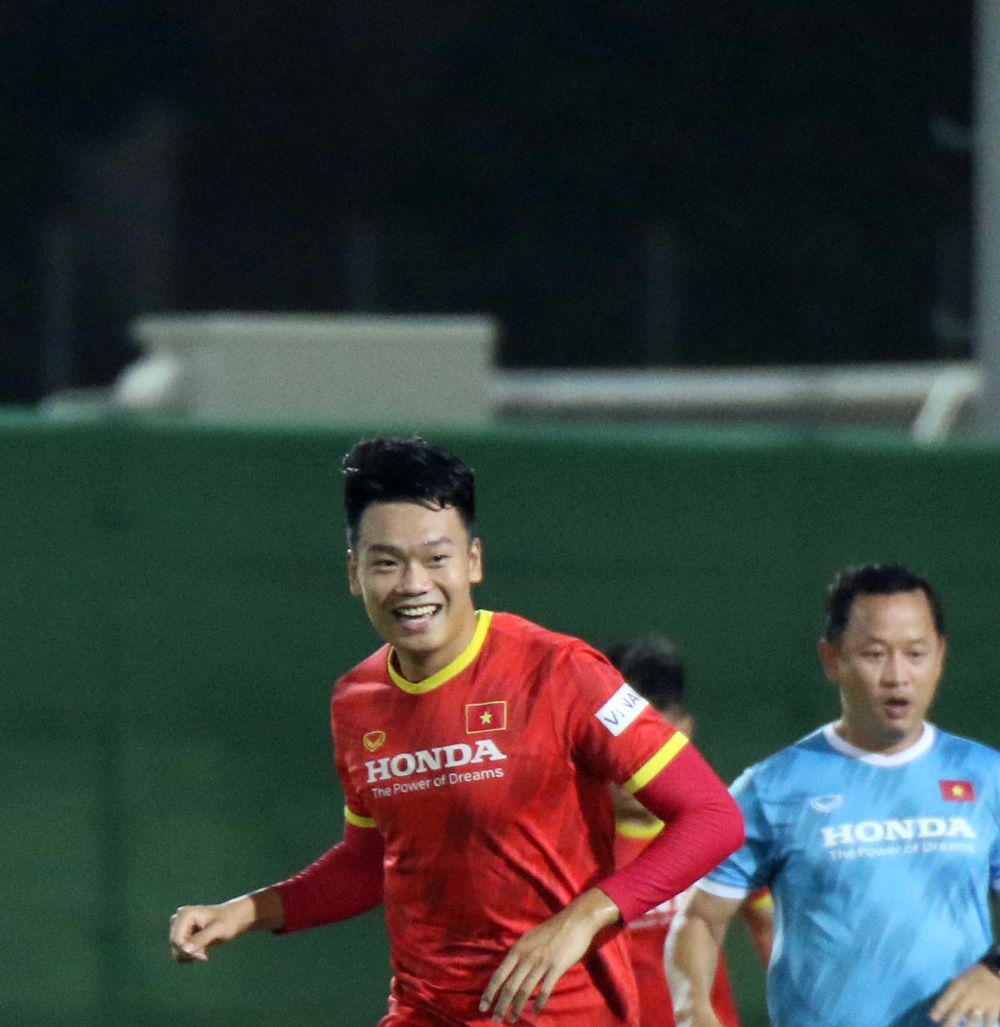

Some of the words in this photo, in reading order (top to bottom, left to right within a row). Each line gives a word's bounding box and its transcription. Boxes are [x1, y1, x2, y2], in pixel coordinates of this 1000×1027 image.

[365, 739, 507, 783] HONDA
[372, 787, 391, 798] The
[393, 779, 431, 795] Power
[433, 775, 447, 787] of
[449, 767, 504, 785] Dreams
[820, 818, 976, 847] HONDA
